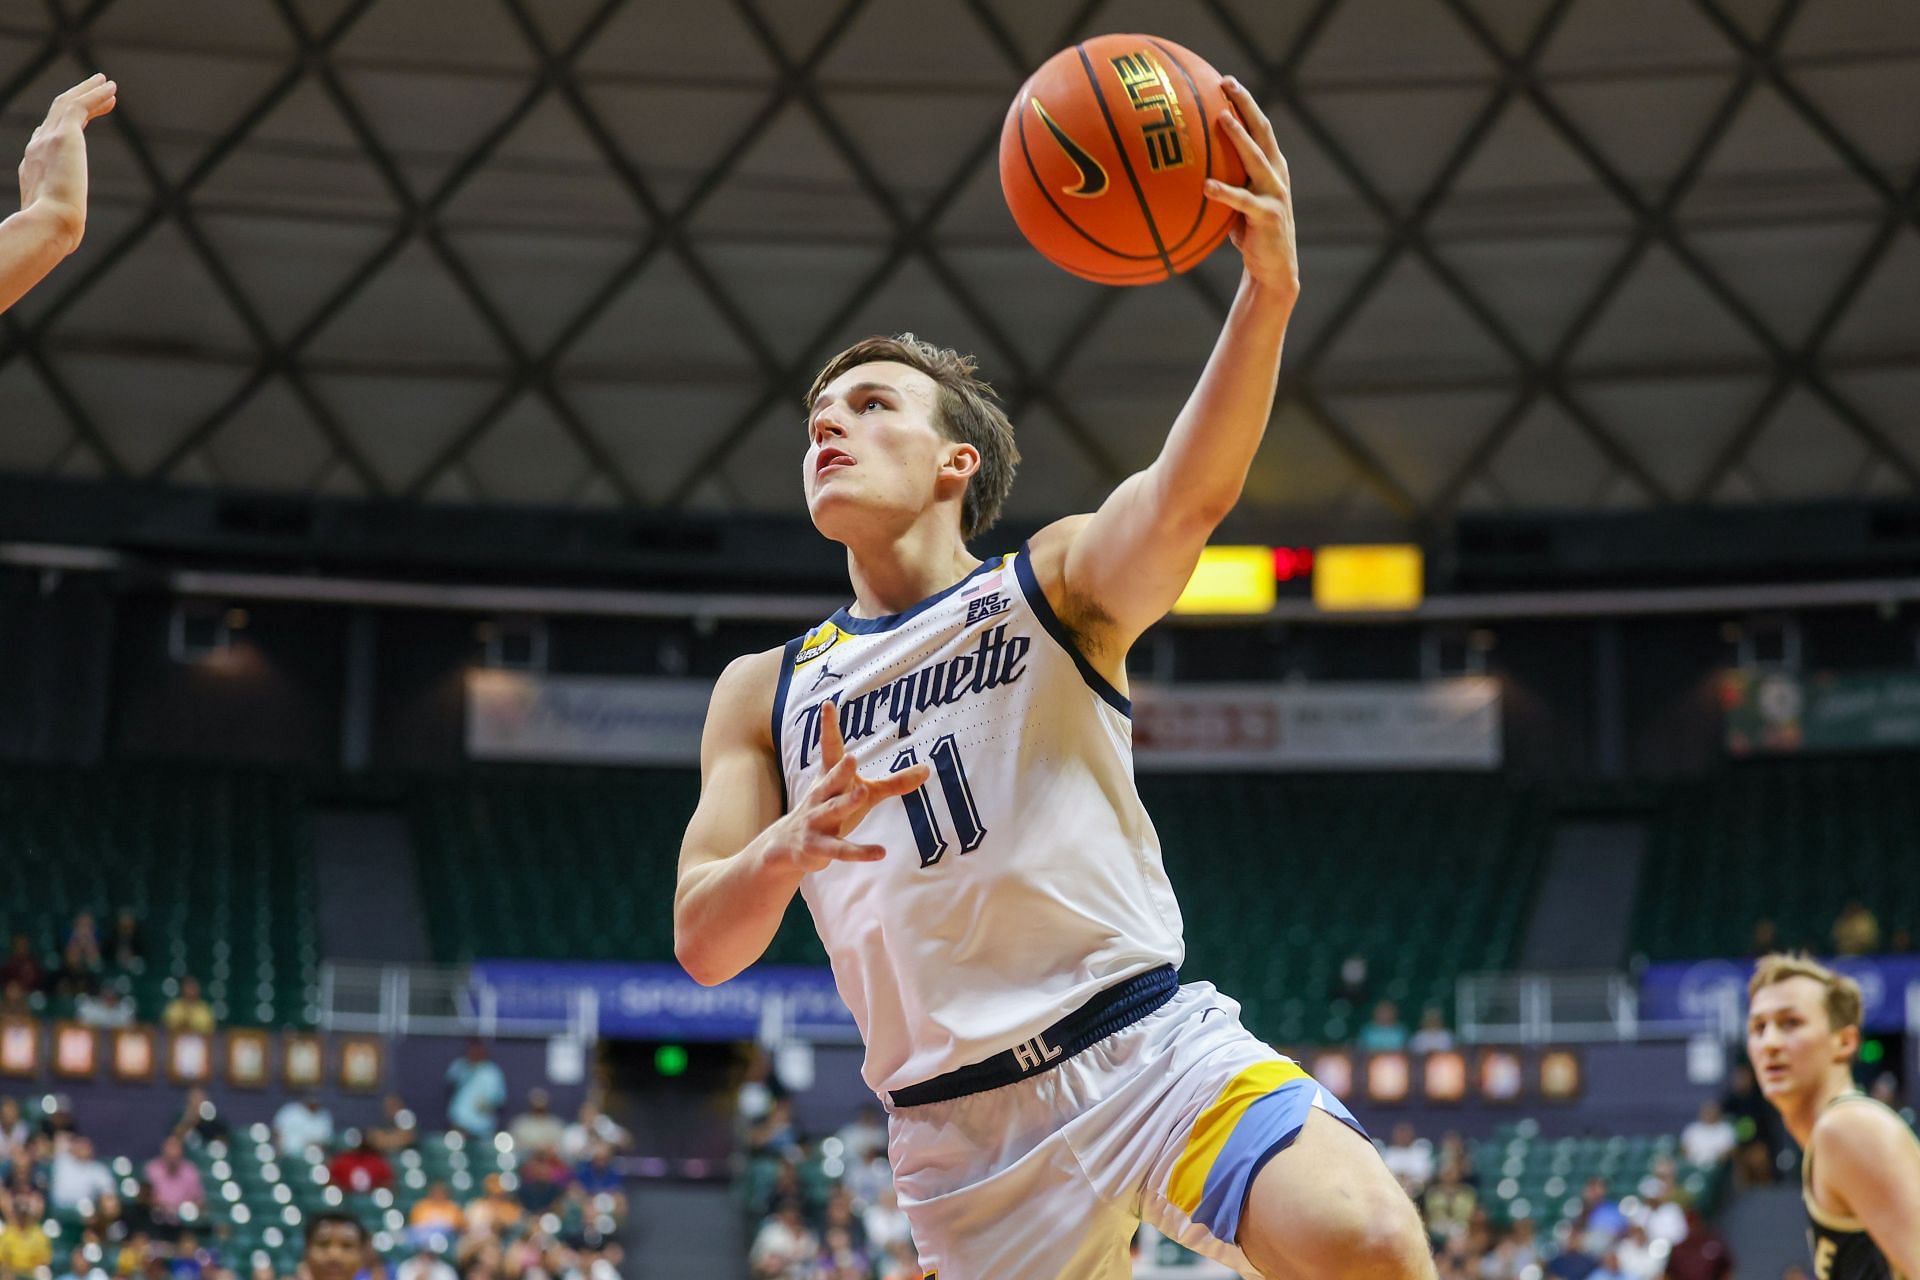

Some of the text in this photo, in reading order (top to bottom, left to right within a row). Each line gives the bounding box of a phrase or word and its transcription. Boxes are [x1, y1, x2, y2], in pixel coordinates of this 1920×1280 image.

[1108, 51, 1185, 172] ELITE
[966, 598, 1011, 622] EAST
[968, 592, 1000, 611] BIG
[795, 624, 1030, 770] Marquette
[889, 732, 988, 869] 11
